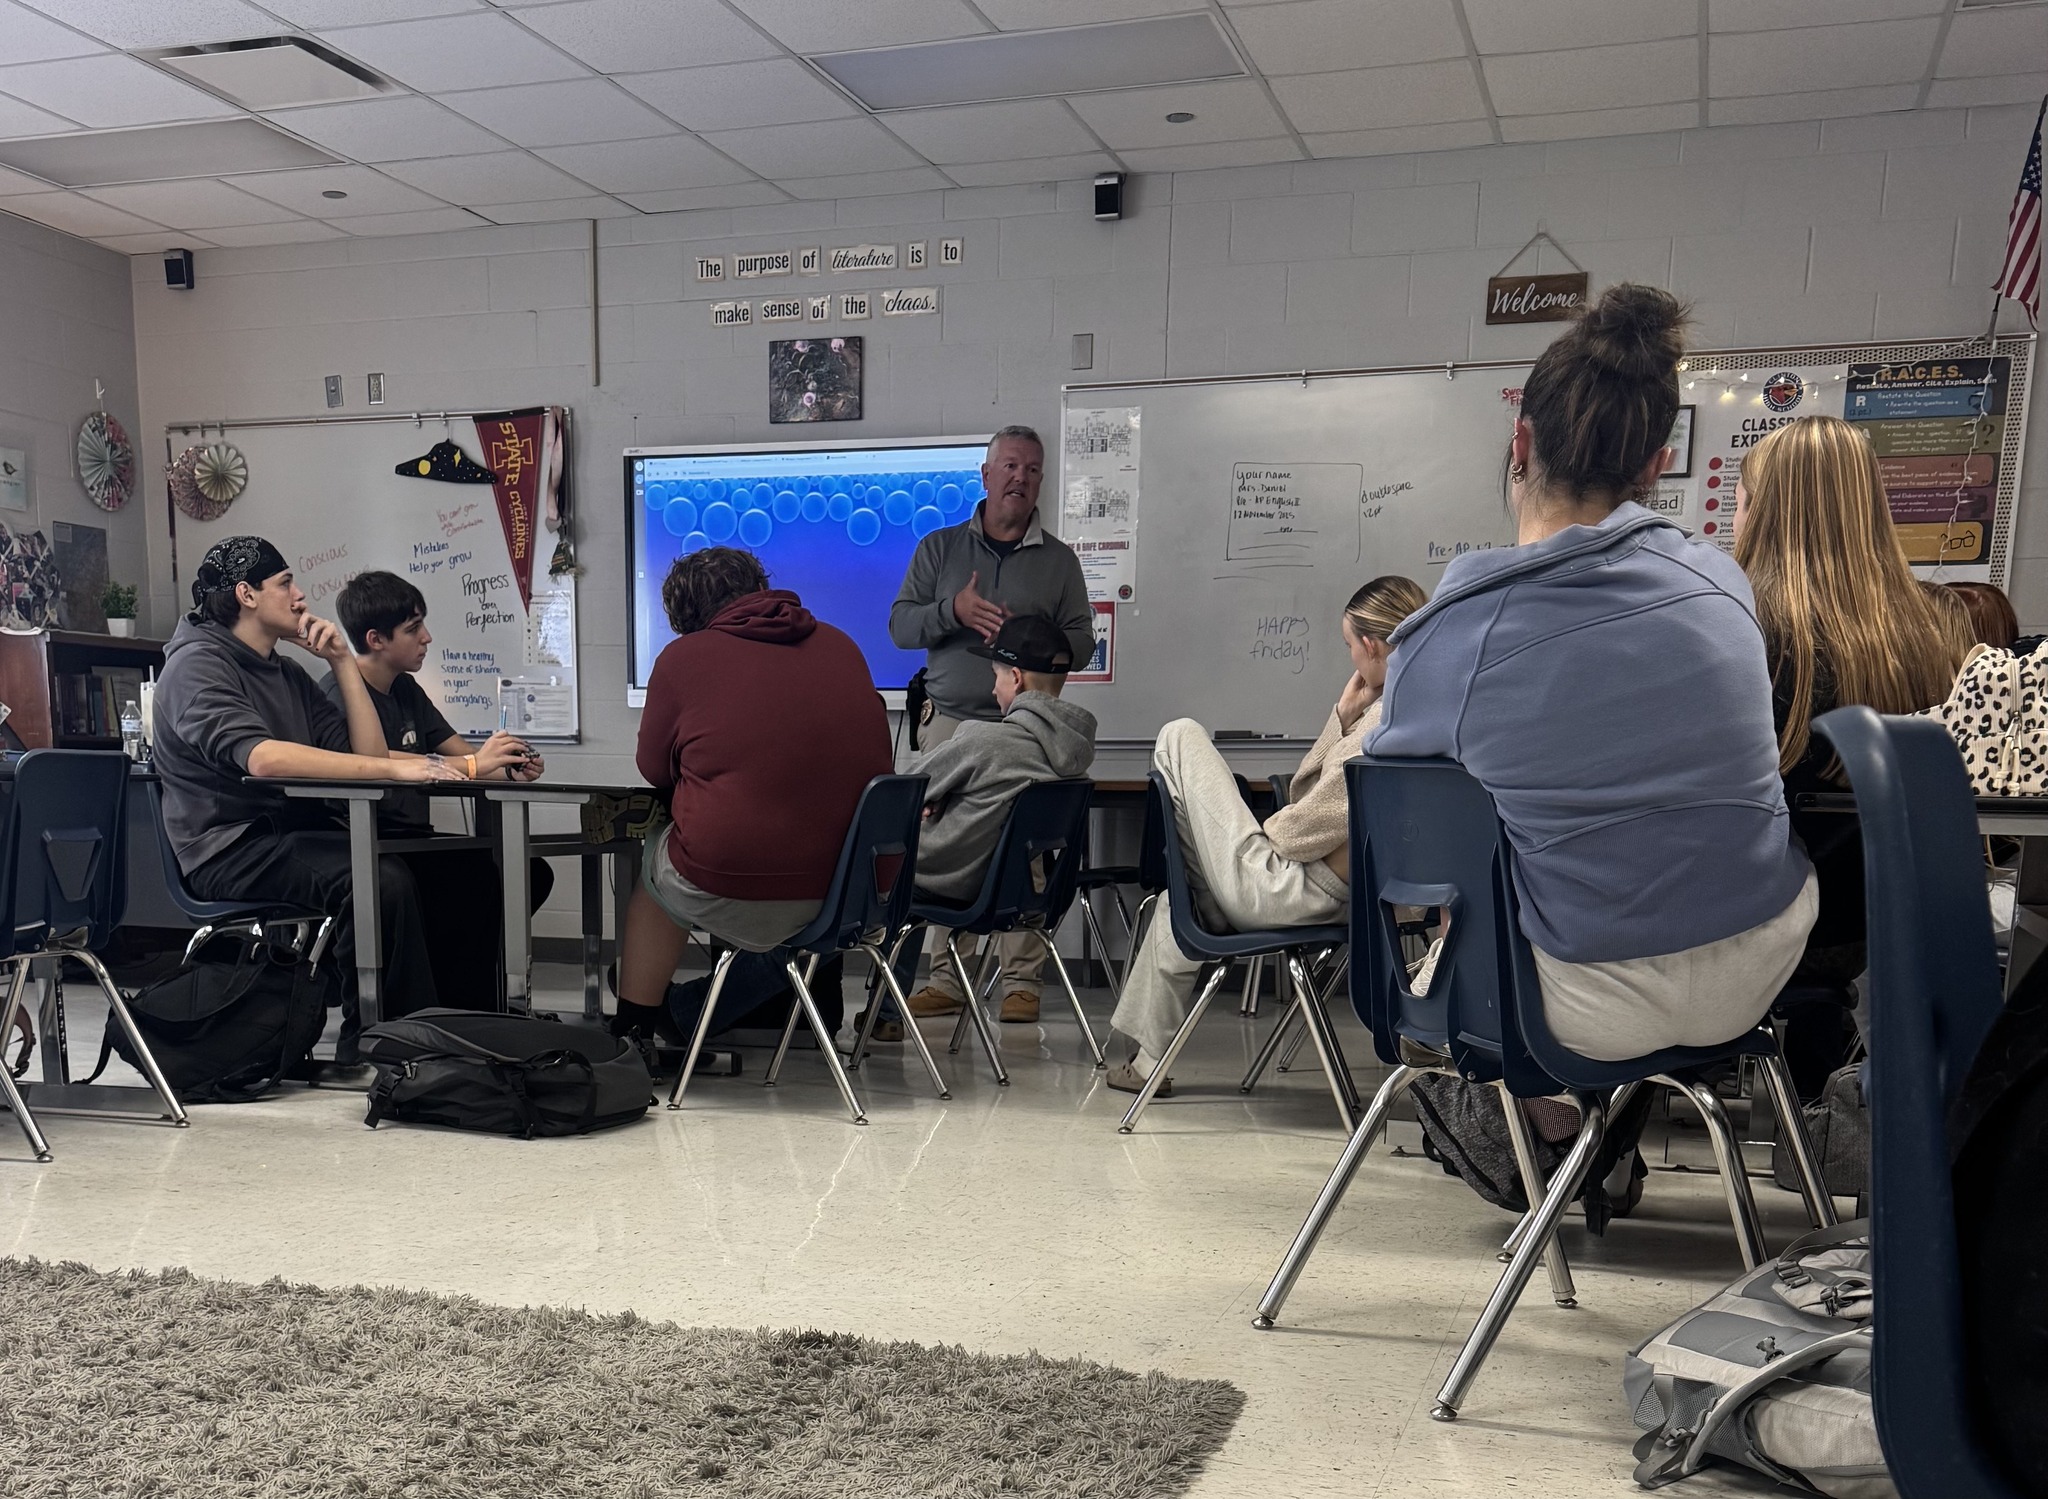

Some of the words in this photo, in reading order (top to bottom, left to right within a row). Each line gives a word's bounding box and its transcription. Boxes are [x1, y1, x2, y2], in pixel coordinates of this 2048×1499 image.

[698, 259, 722, 278] The
[737, 254, 790, 276] purpose
[802, 252, 816, 269] of
[832, 248, 895, 269] literature
[911, 246, 923, 264] is
[944, 242, 959, 261] to
[714, 307, 750, 324] make
[763, 301, 800, 318] sense
[812, 301, 826, 319] of
[845, 296, 866, 315] the
[884, 289, 936, 312] chaos.
[1491, 282, 1580, 315] Welcome
[1880, 365, 1964, 381] R.A.C.E.S.
[1855, 394, 1867, 407] R
[499, 421, 521, 487] STATE
[1651, 495, 1678, 509] ead
[509, 490, 526, 559] CYCLONES
[408, 561, 430, 574] Help
[448, 549, 473, 570] grow
[413, 541, 450, 558] Mistakes
[461, 573, 510, 604] Progress
[465, 610, 515, 633] Perfection
[442, 648, 461, 661] Have
